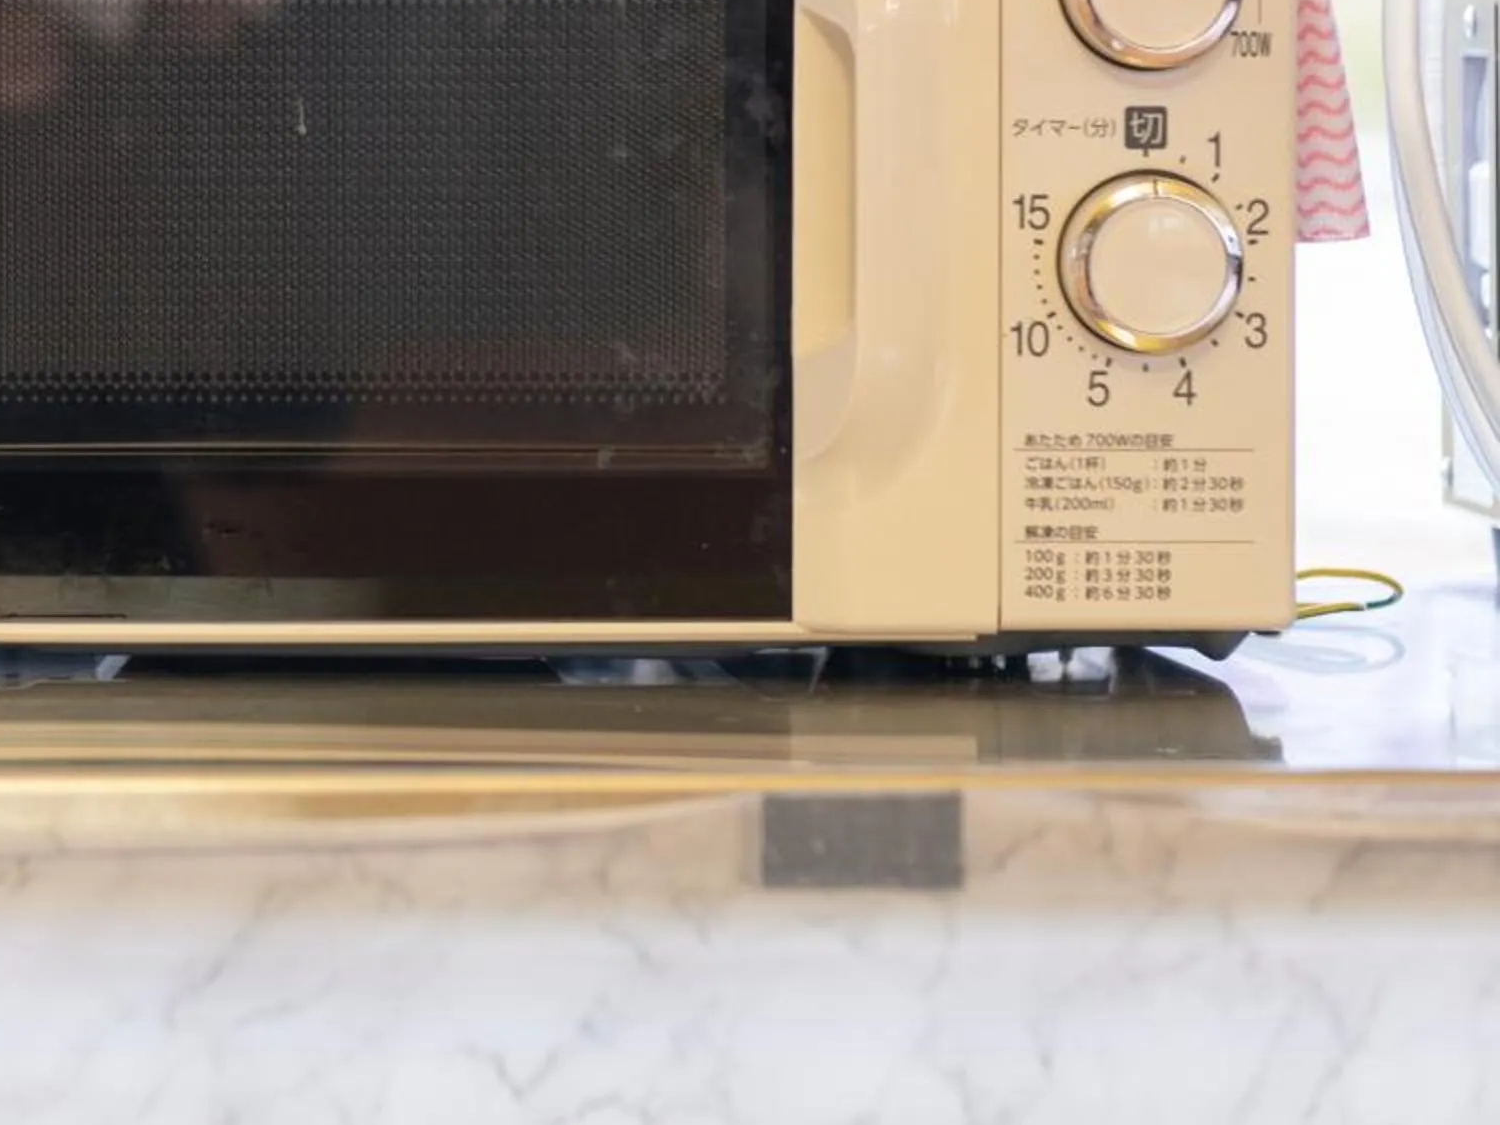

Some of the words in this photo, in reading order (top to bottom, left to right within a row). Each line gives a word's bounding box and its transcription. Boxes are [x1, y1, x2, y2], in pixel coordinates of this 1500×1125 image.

[1232, 32, 1272, 57] 700W
[1129, 112, 1164, 145] 切
[1207, 131, 1221, 167] 1
[1012, 194, 1051, 231] 15
[1246, 199, 1270, 236] 2
[1010, 321, 1050, 357] 10
[1245, 312, 1268, 349] 3
[1086, 371, 1111, 407] 5
[1172, 370, 1197, 406] 4
[1024, 549, 1066, 566] 100g
[1024, 567, 1066, 584] 200g
[1024, 584, 1066, 602] 400g
